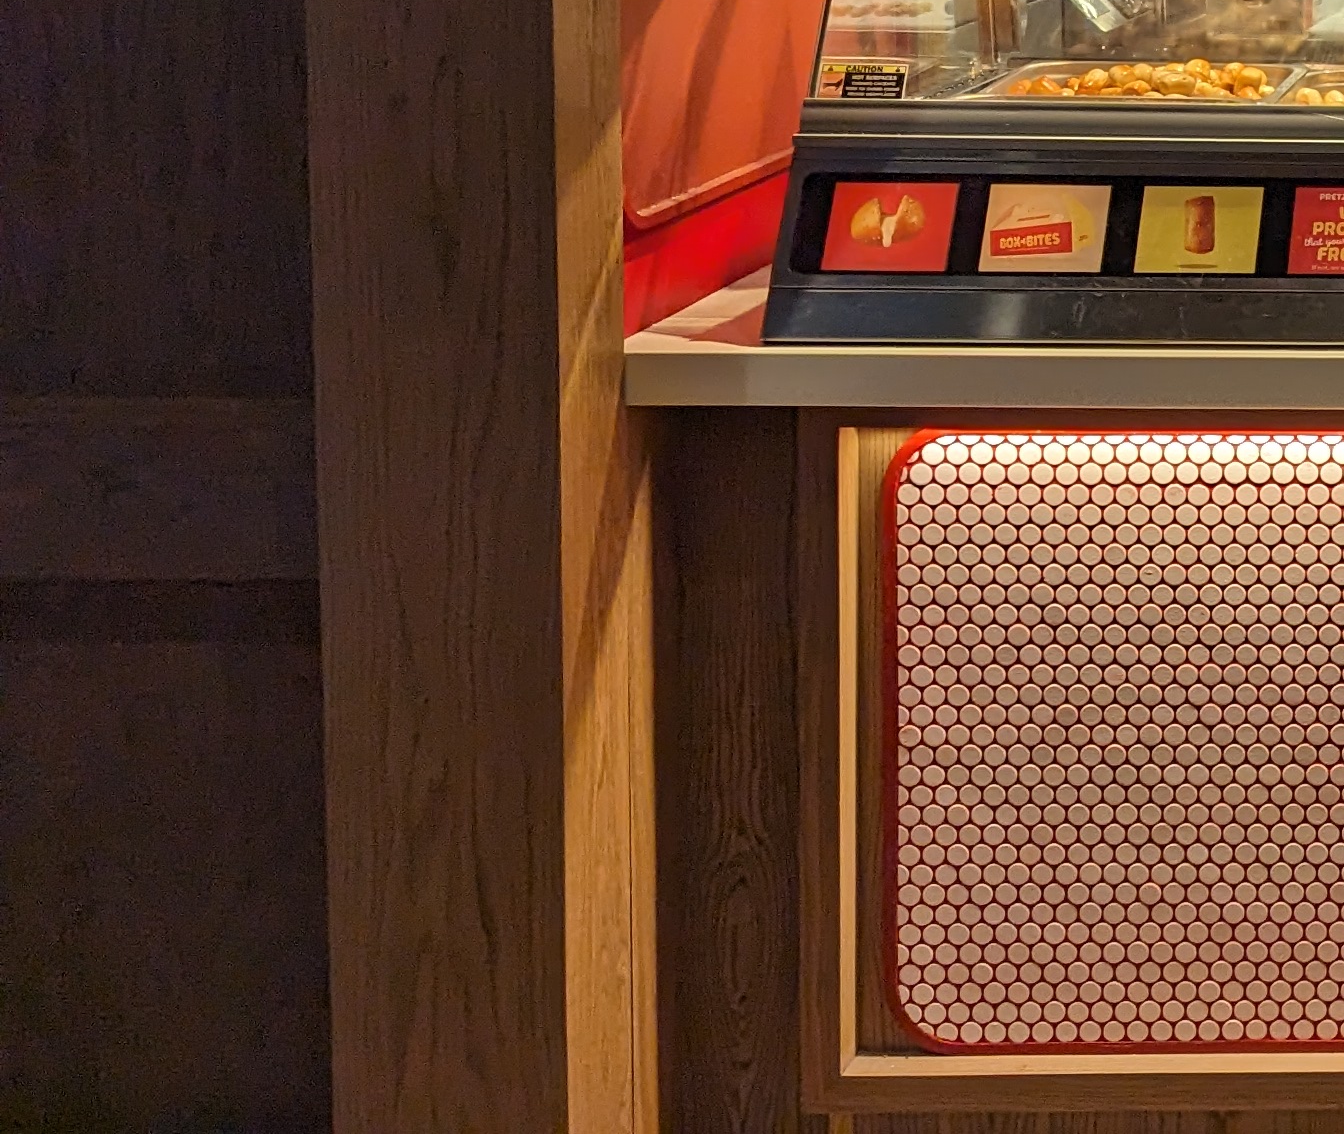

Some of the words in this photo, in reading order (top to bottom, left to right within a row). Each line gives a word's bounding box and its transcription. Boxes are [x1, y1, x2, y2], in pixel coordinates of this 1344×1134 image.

[1000, 236, 1022, 249] BOX
[1027, 233, 1060, 247] BITES
[1304, 237, 1323, 247] that
